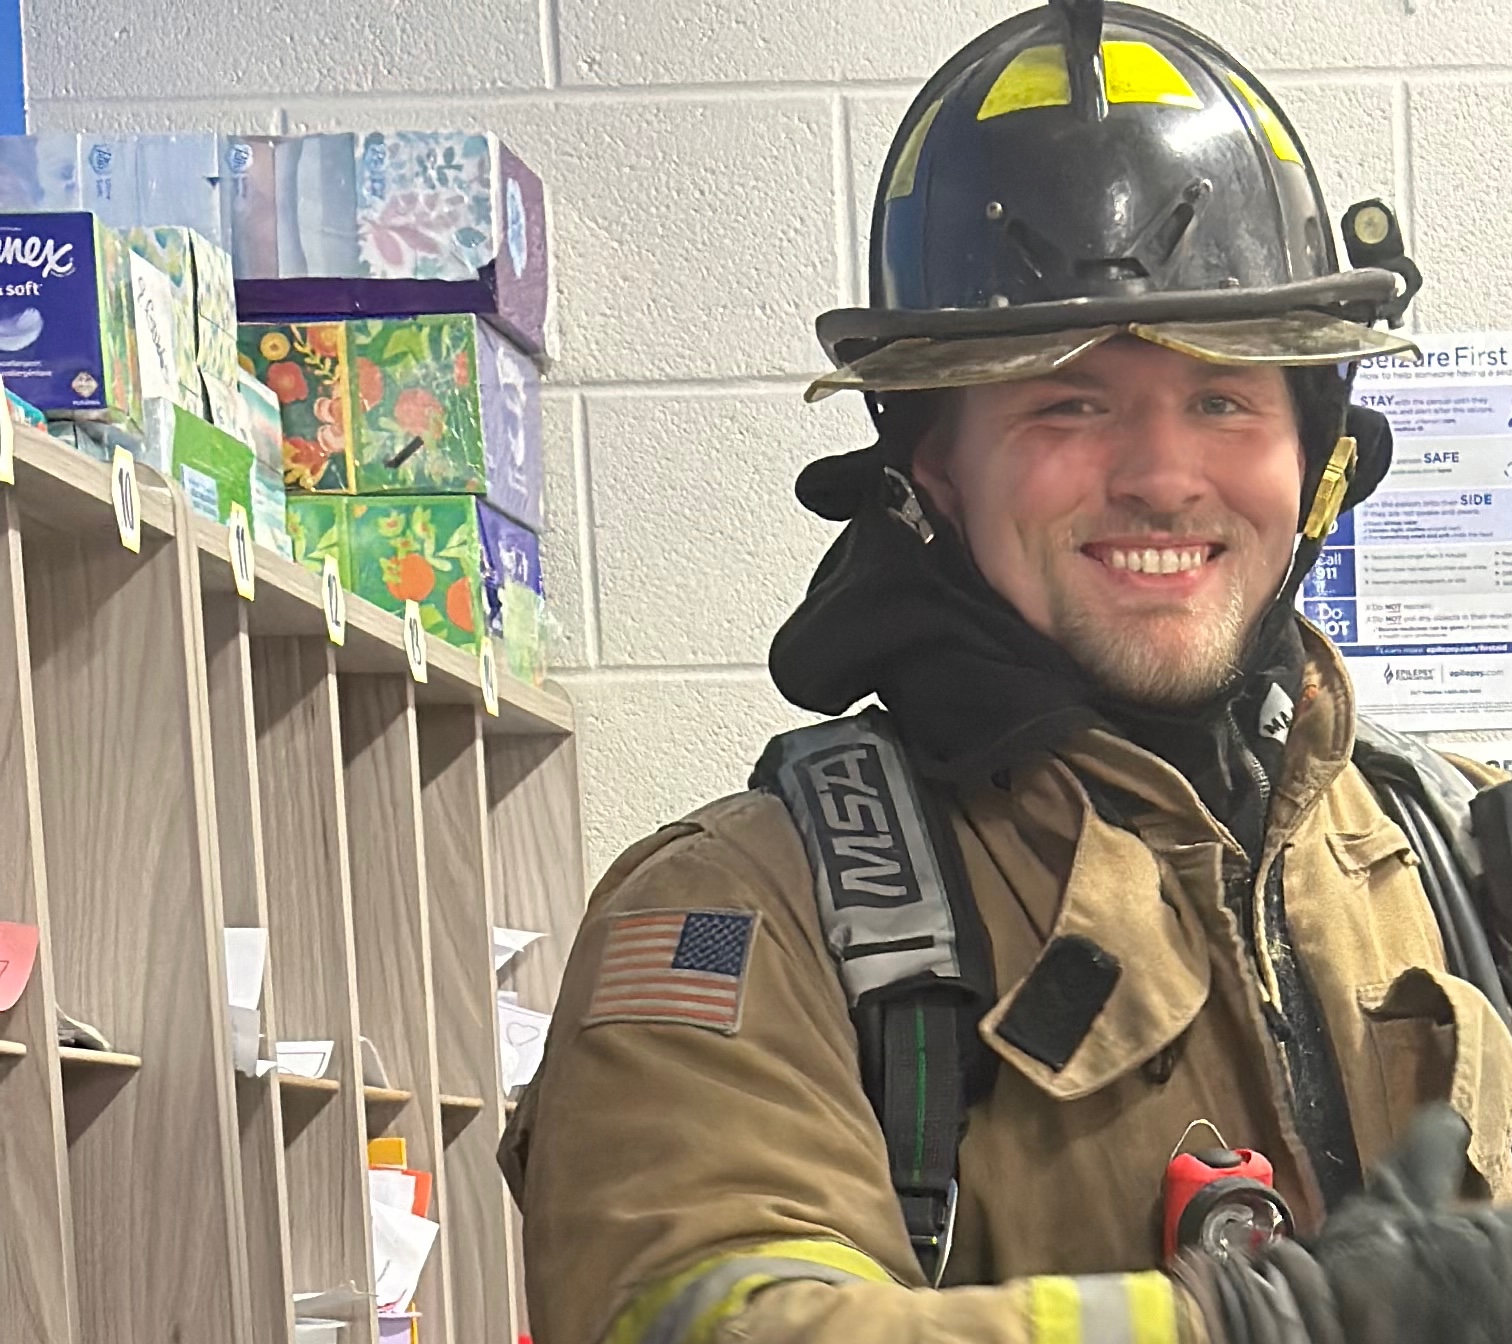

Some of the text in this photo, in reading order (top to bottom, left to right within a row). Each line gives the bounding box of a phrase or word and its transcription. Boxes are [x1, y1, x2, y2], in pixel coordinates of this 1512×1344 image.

[0, 236, 73, 278] nex
[5, 281, 40, 296] soft
[1455, 345, 1508, 367] First
[1360, 395, 1395, 407] STAY
[1423, 451, 1460, 465] SAFE
[118, 467, 134, 531] 10
[1460, 493, 1493, 506] SIDE
[235, 524, 249, 581] 11
[1316, 553, 1342, 566] Call
[1315, 567, 1338, 580] 911
[1318, 602, 1343, 620] Do
[1385, 603, 1402, 612] NOT
[1386, 615, 1402, 624] NOT
[809, 749, 907, 897] MSA
